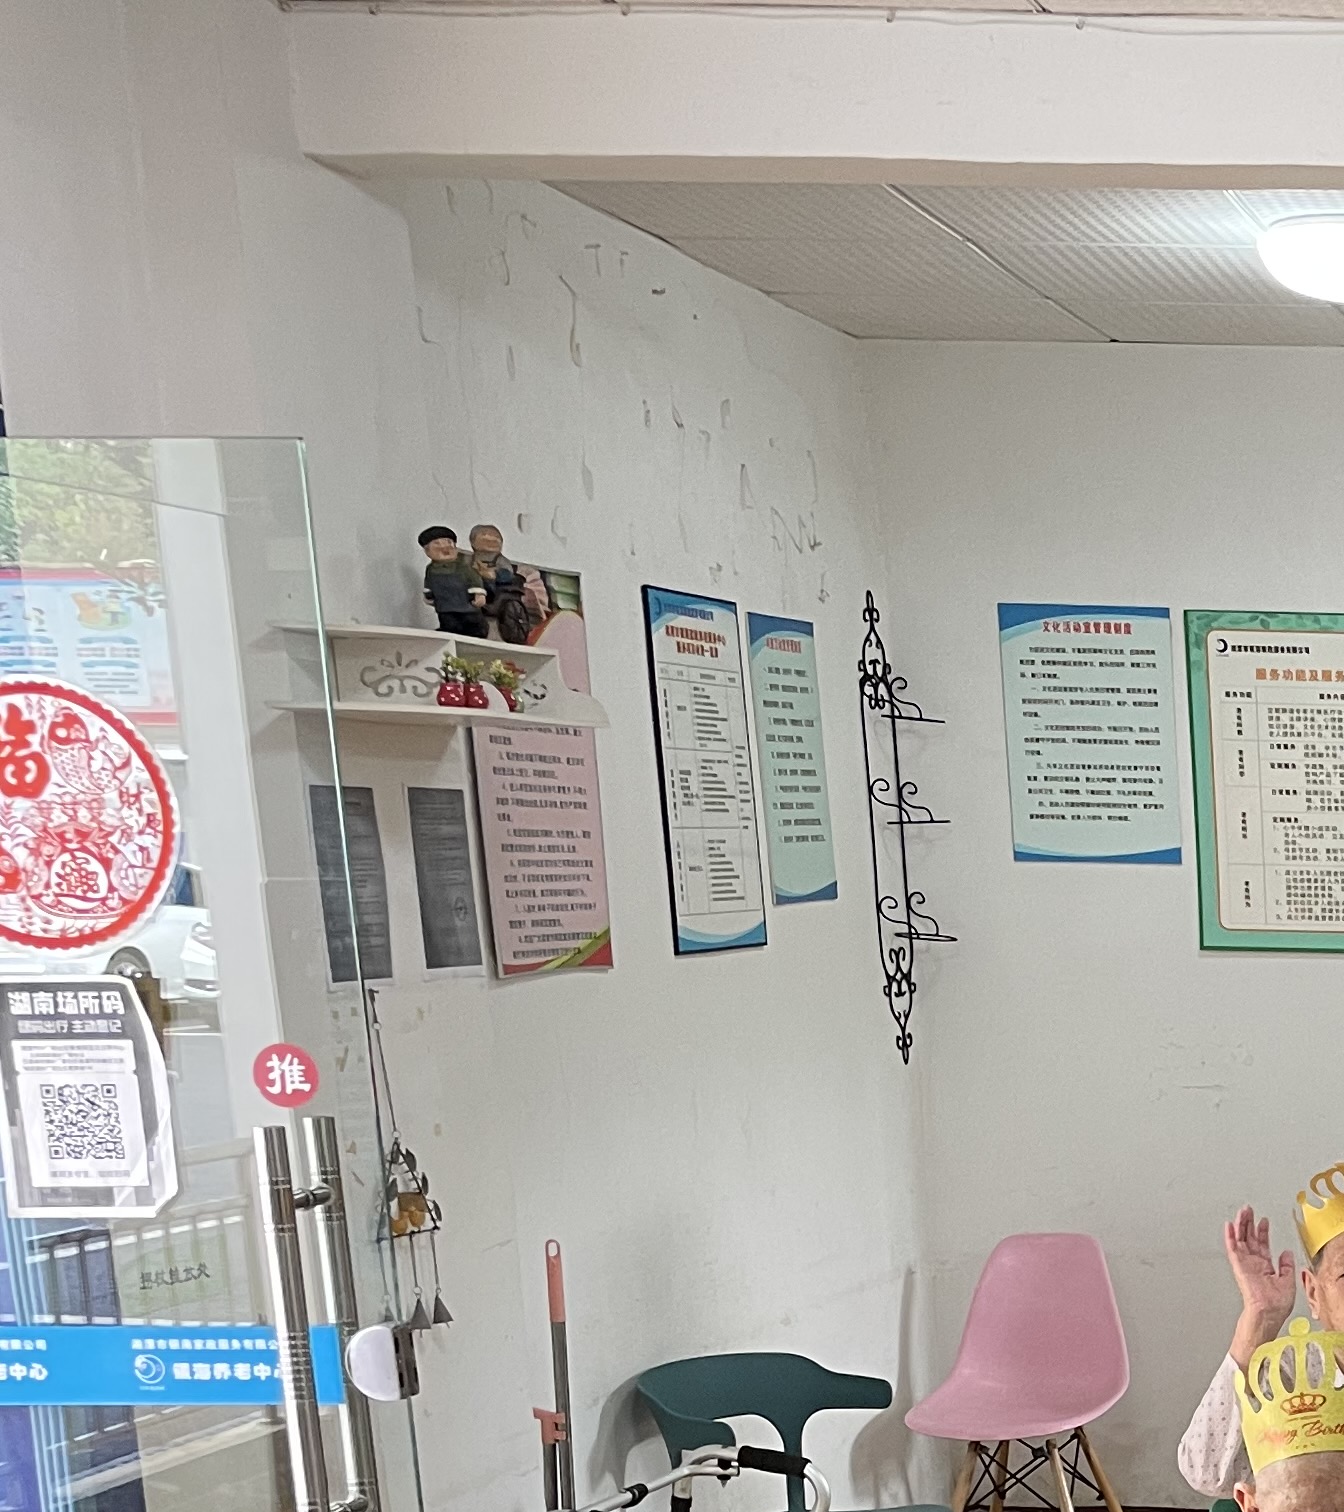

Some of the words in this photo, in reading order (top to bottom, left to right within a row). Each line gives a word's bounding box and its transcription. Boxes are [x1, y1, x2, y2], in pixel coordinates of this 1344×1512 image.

[7, 991, 125, 1015] 湖南场所码
[266, 1054, 312, 1096] 推
